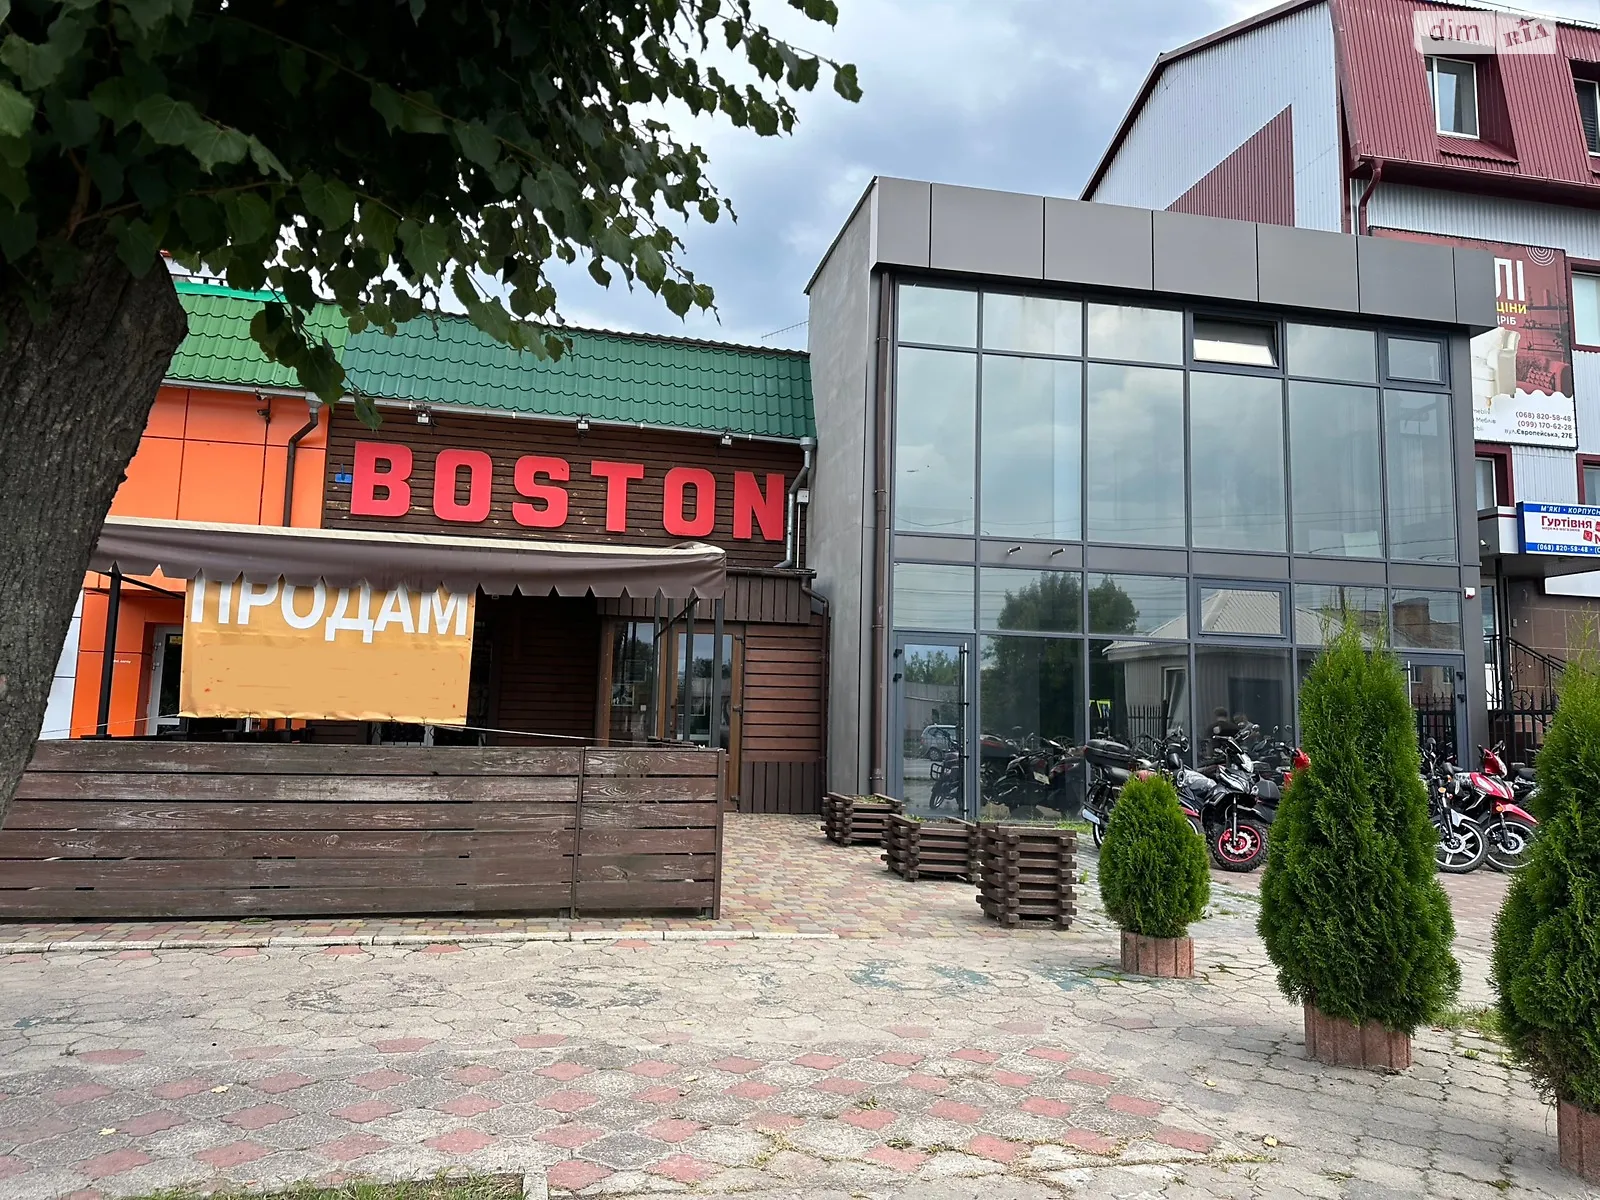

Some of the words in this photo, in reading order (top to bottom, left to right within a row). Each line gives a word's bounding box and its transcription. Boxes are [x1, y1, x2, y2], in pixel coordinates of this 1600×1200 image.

[1515, 411, 1535, 420] (068)
[1536, 413, 1572, 422] 820-58-48
[1517, 420, 1538, 429] (099)
[1538, 422, 1573, 431] 170-62-28
[350, 441, 785, 541] BOSTON
[1541, 515, 1592, 529] Гуртівня
[1537, 543, 1554, 552] (068)
[1555, 544, 1588, 553] 820-58-48
[190, 570, 469, 644] ПРОДАМ
